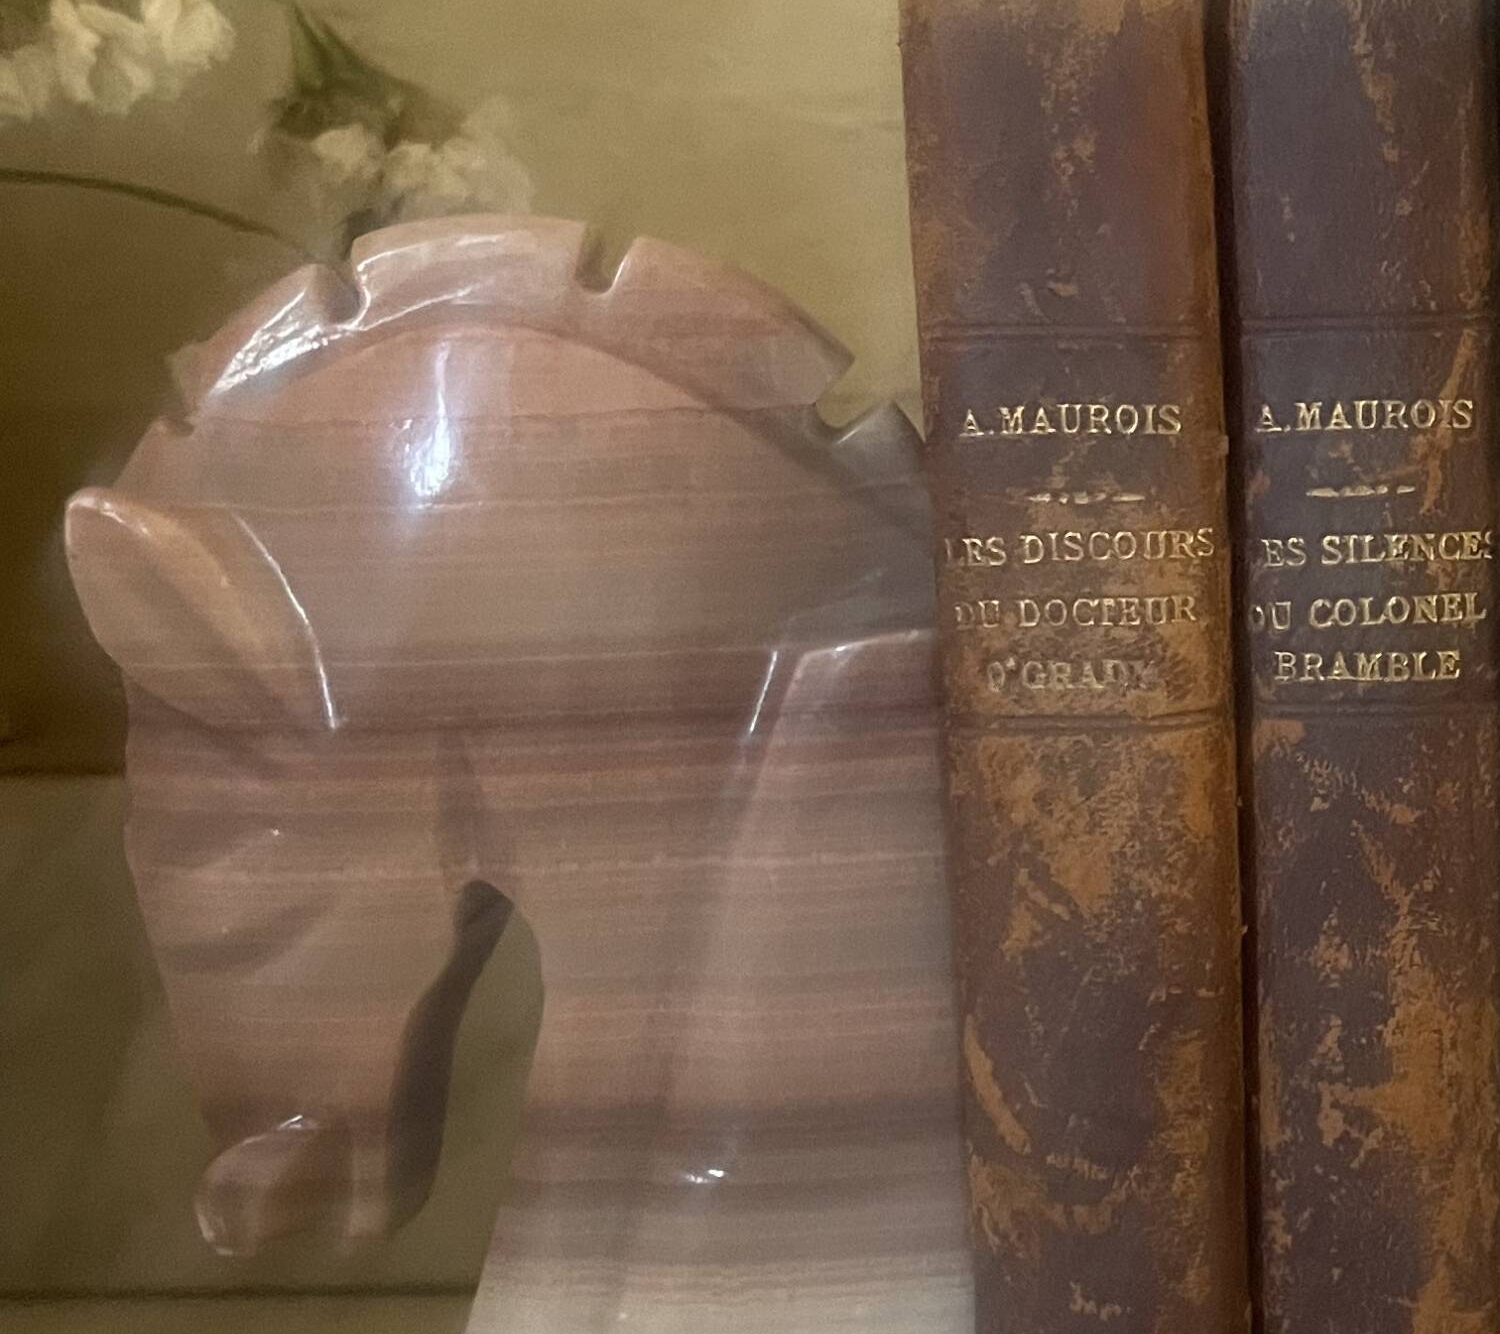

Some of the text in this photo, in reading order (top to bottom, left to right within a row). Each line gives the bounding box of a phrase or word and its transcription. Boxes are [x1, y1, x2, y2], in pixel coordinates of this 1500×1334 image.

[1018, 527, 1215, 565] DISCOURS
[954, 595, 1198, 630] DU DOCTEUR
[1308, 591, 1487, 629] COLONEL
[1273, 649, 1461, 683] BRAMBLE
